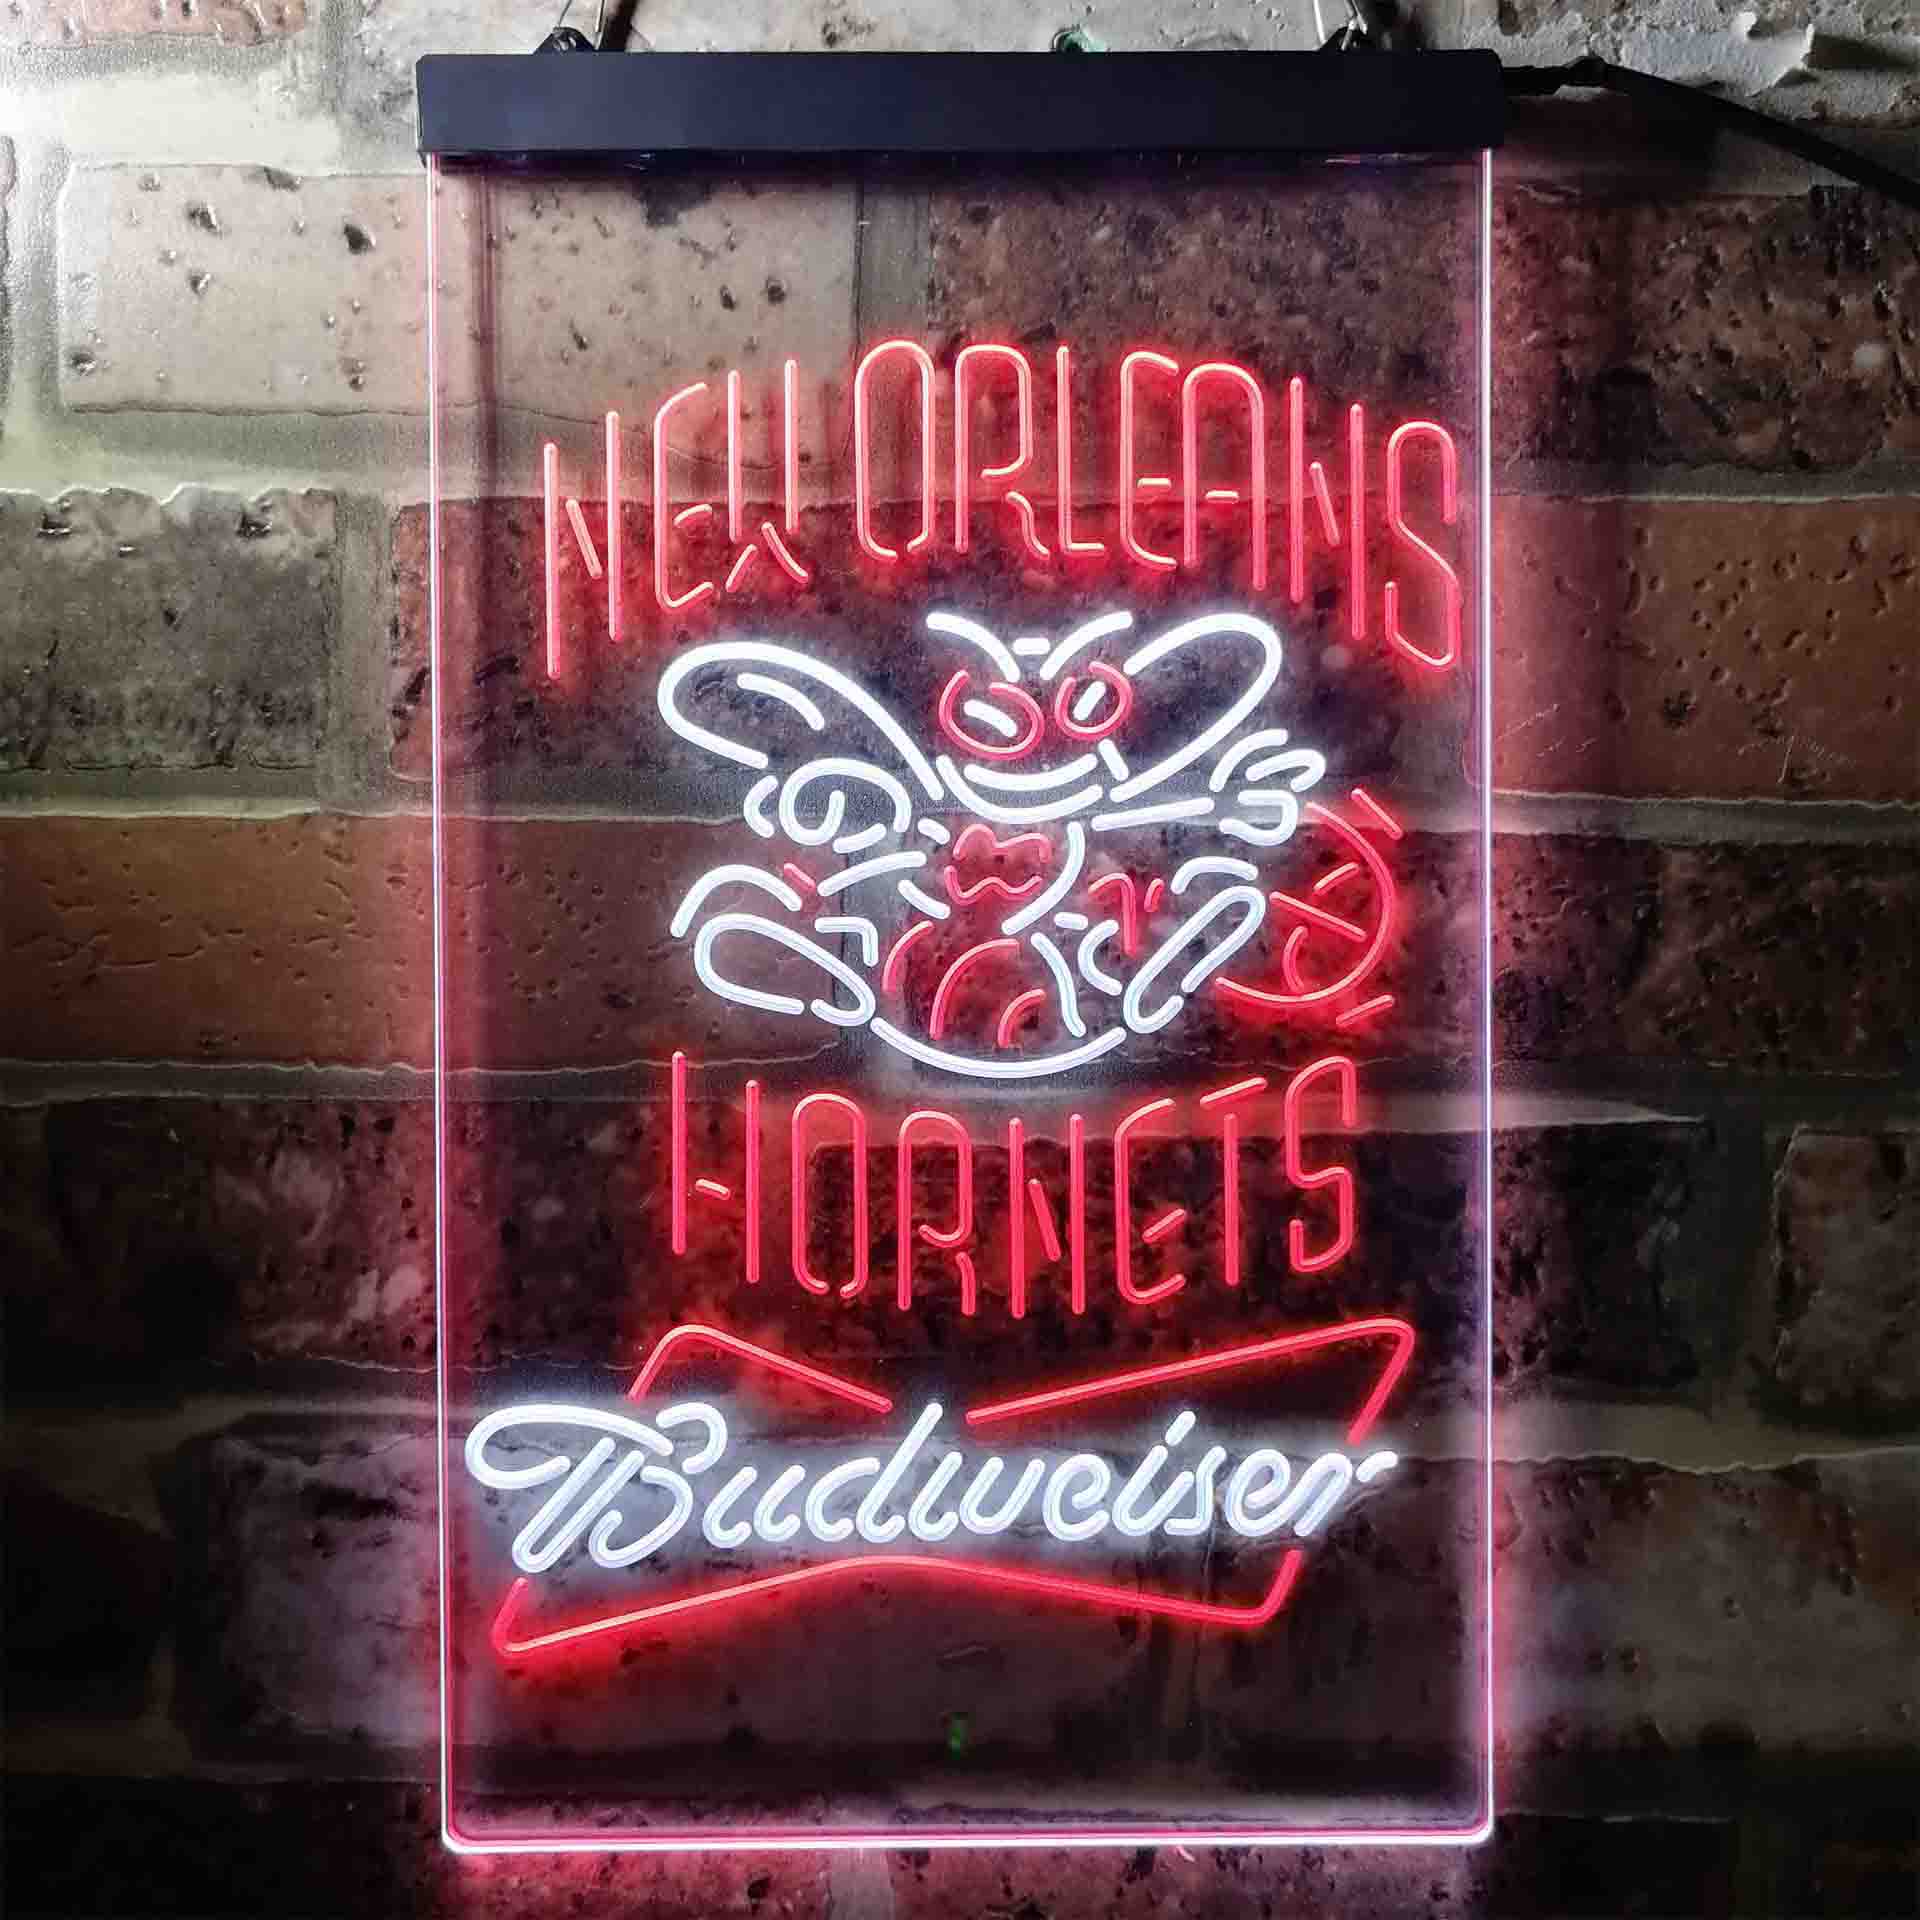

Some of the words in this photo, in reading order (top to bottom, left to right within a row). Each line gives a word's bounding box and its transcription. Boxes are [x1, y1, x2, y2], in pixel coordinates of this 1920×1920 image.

[543, 358, 809, 679] NEW
[853, 339, 1461, 667] ORLEANS
[672, 1050, 1358, 1319] HORNETS
[465, 1402, 1399, 1575] Budweiser
